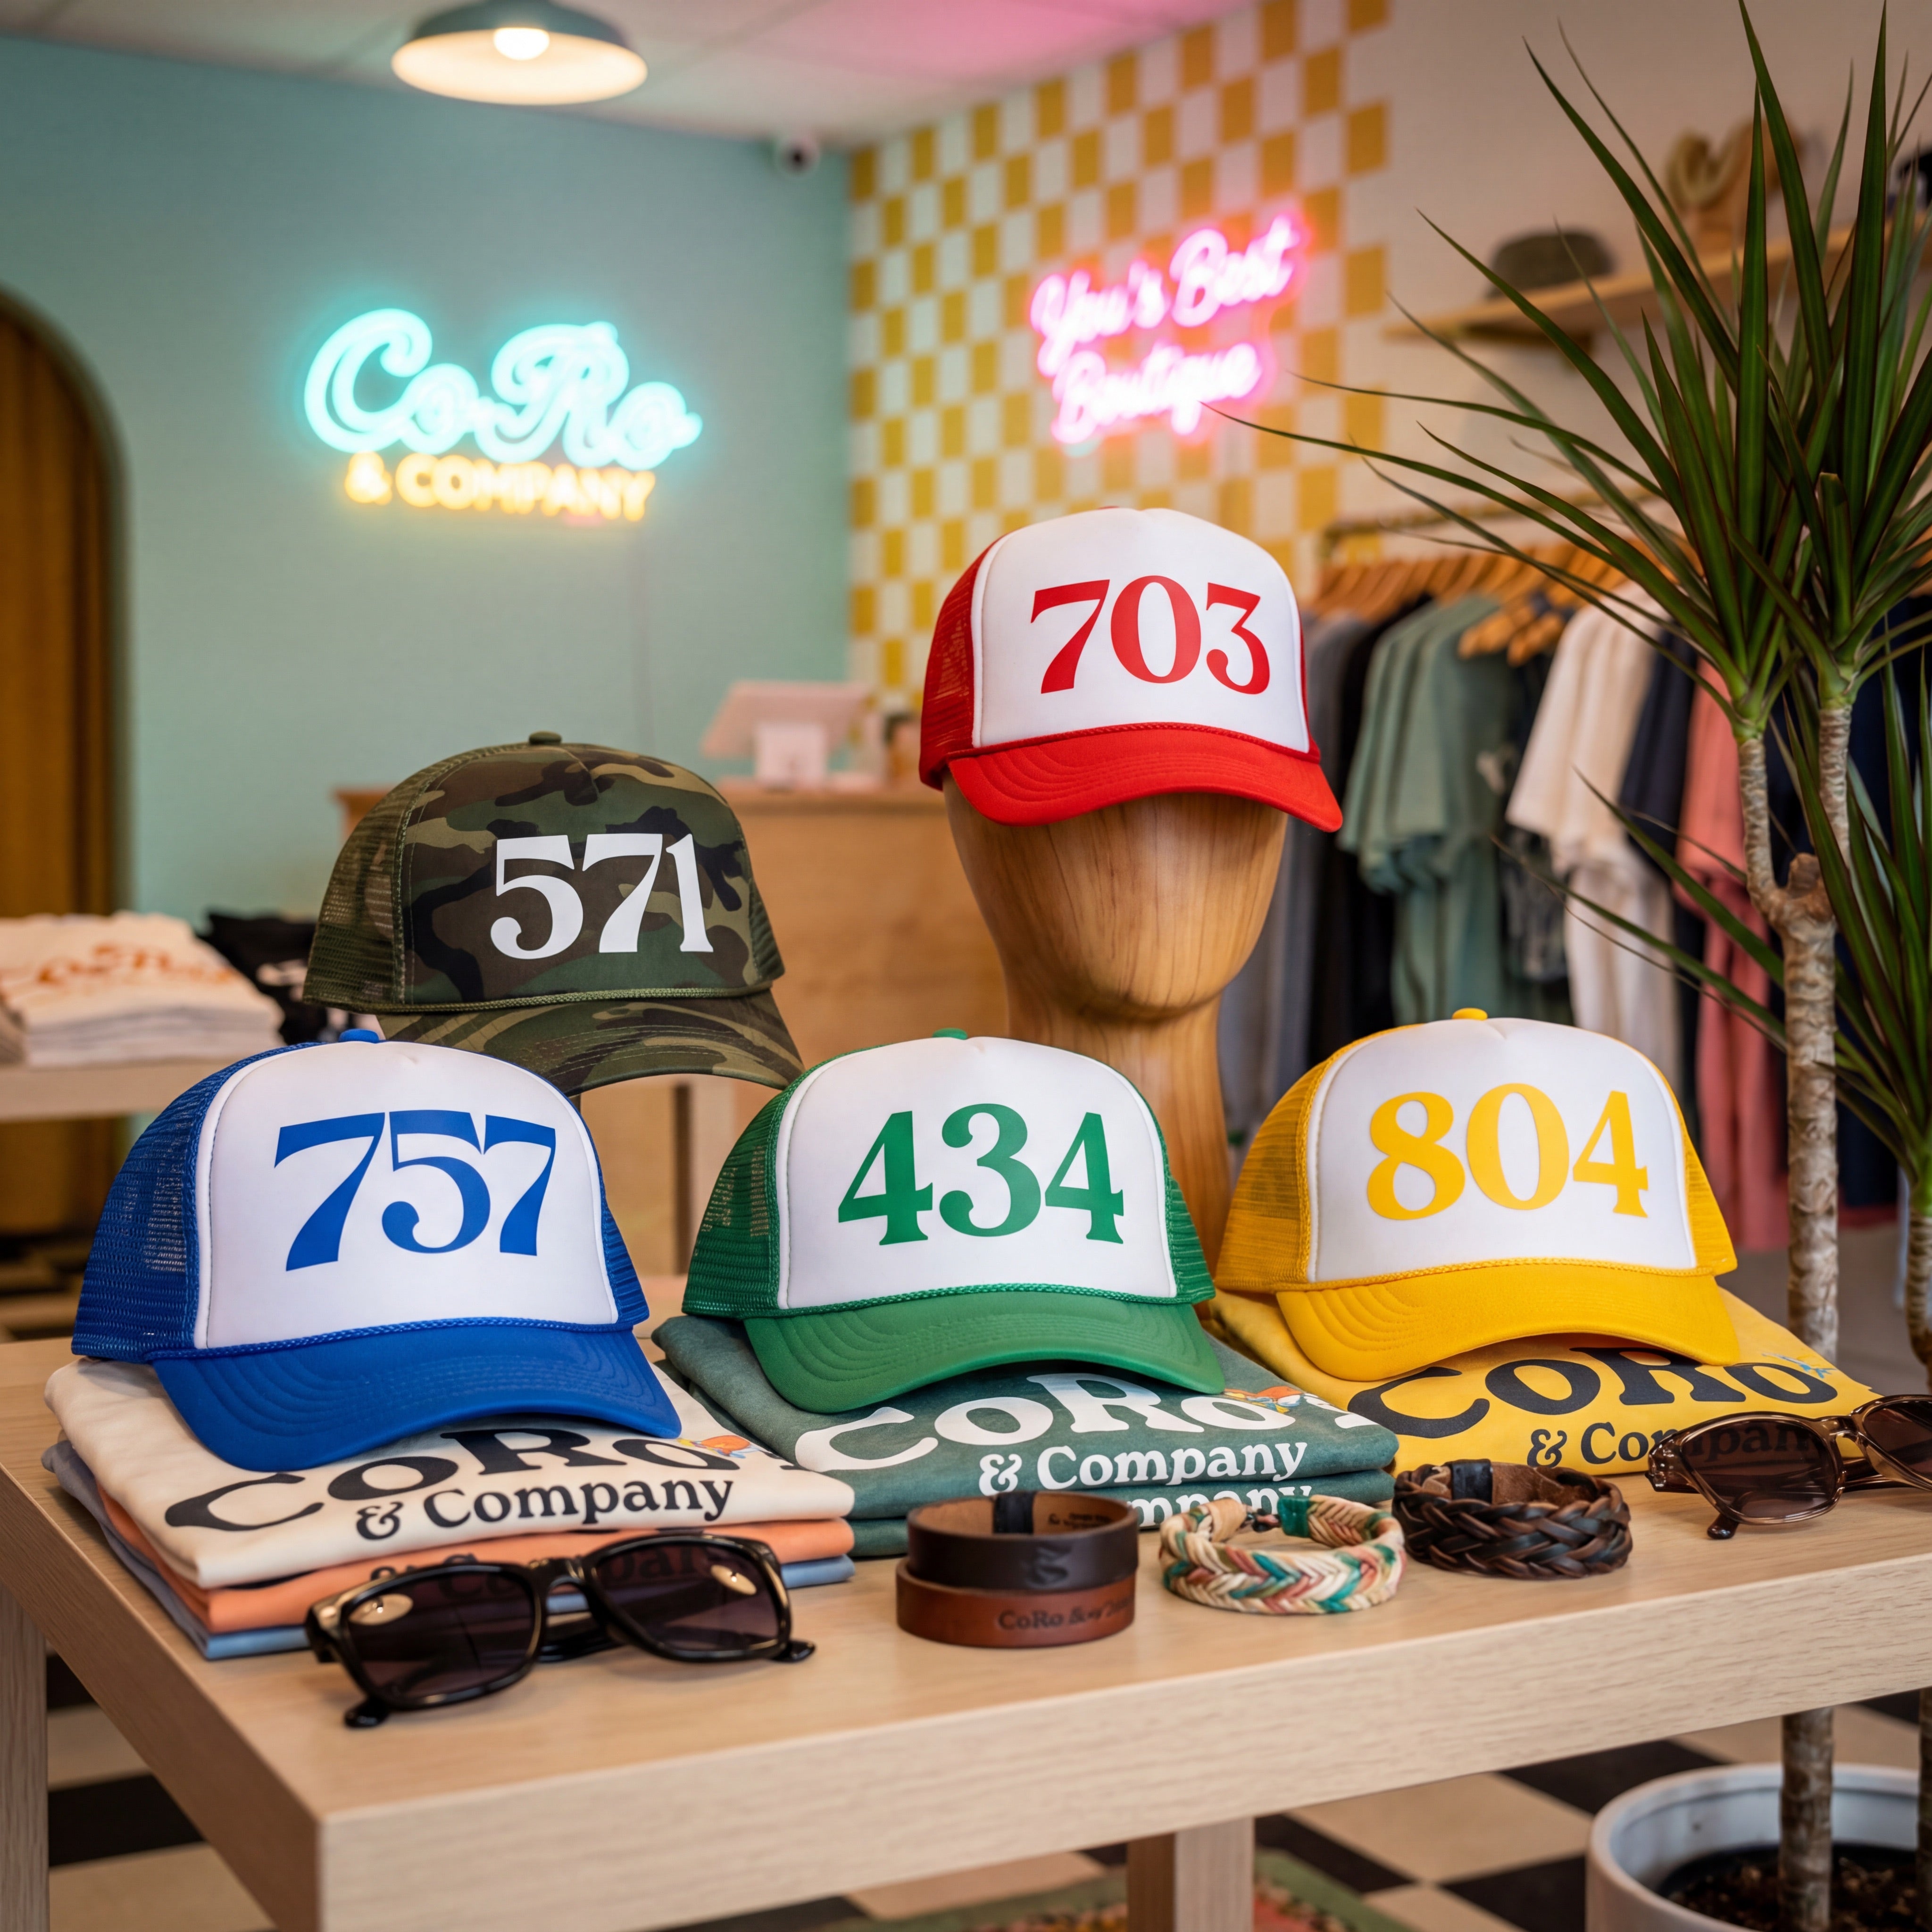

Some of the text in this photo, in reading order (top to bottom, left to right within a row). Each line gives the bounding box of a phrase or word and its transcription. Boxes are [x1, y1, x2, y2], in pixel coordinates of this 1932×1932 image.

[304, 308, 703, 471] CoRo
[344, 451, 657, 522] & COMPANY
[1031, 576, 1270, 694] 703
[491, 833, 713, 959] 571
[275, 1110, 556, 1272] 757
[839, 1104, 1124, 1245] 434
[1367, 1083, 1648, 1221] 804
[979, 1442, 1308, 1496] & Company
[1527, 1429, 1567, 1468] &
[357, 1480, 733, 1540] & Company
[998, 1609, 1065, 1630] CoRo
